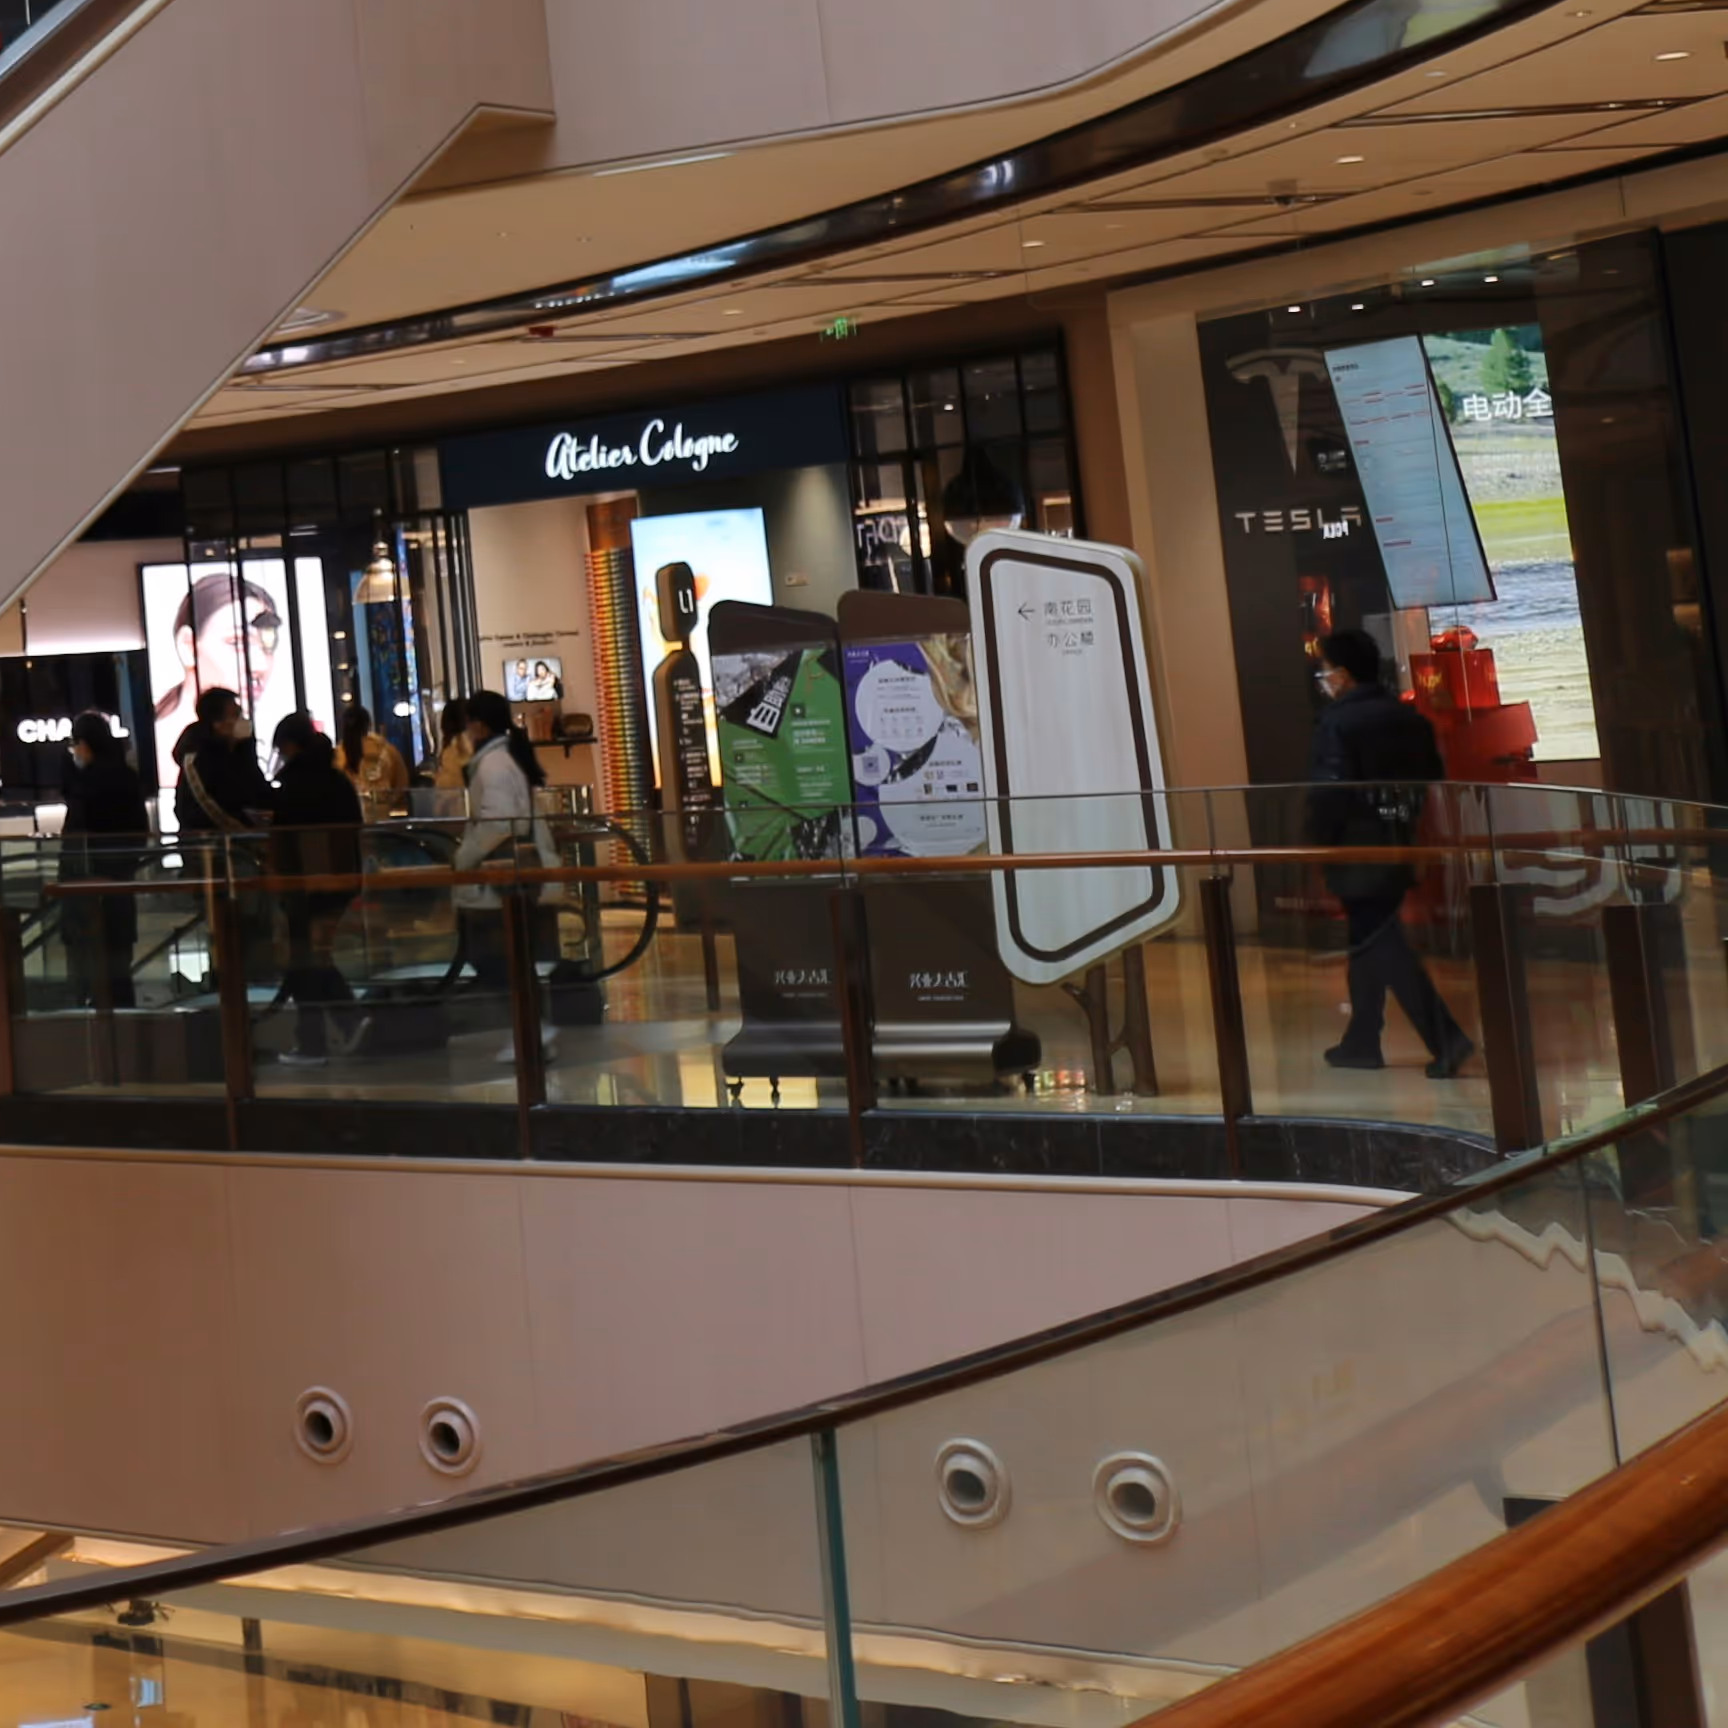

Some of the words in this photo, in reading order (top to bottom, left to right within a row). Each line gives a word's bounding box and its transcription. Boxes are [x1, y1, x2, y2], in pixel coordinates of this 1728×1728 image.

[1462, 386, 1554, 422] 电动全
[545, 432, 637, 480] Atelier
[638, 418, 739, 472] Cologne
[1234, 506, 1363, 534] TESLA
[677, 588, 694, 614] L1
[16, 715, 131, 744] CHAL
